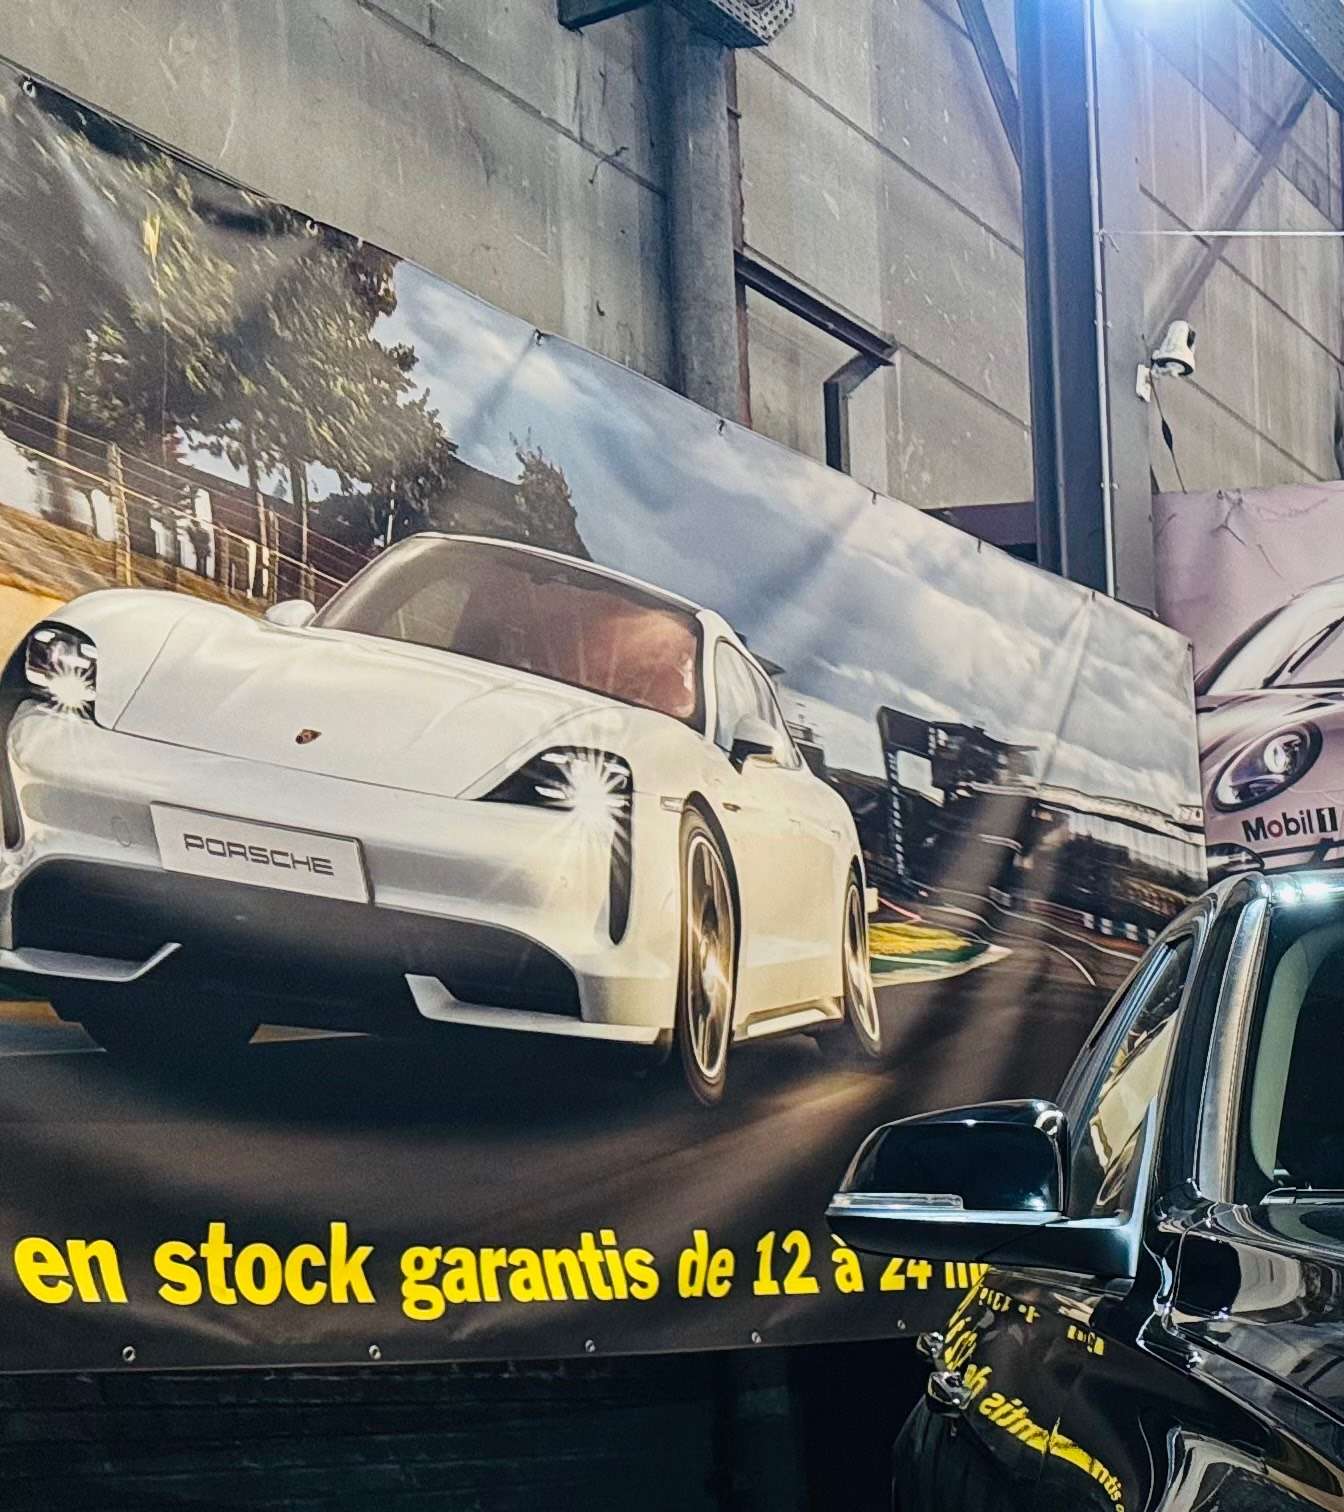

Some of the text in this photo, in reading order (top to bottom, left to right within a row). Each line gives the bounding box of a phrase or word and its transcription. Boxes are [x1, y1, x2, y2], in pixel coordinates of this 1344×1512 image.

[1242, 809, 1315, 842] Mobil
[182, 833, 336, 877] PORSCHE
[13, 1235, 129, 1304] en
[153, 1221, 376, 1307] stock
[400, 1228, 659, 1321] garantis
[677, 1228, 735, 1299] de
[753, 1229, 821, 1296] 12
[830, 1233, 865, 1294] à
